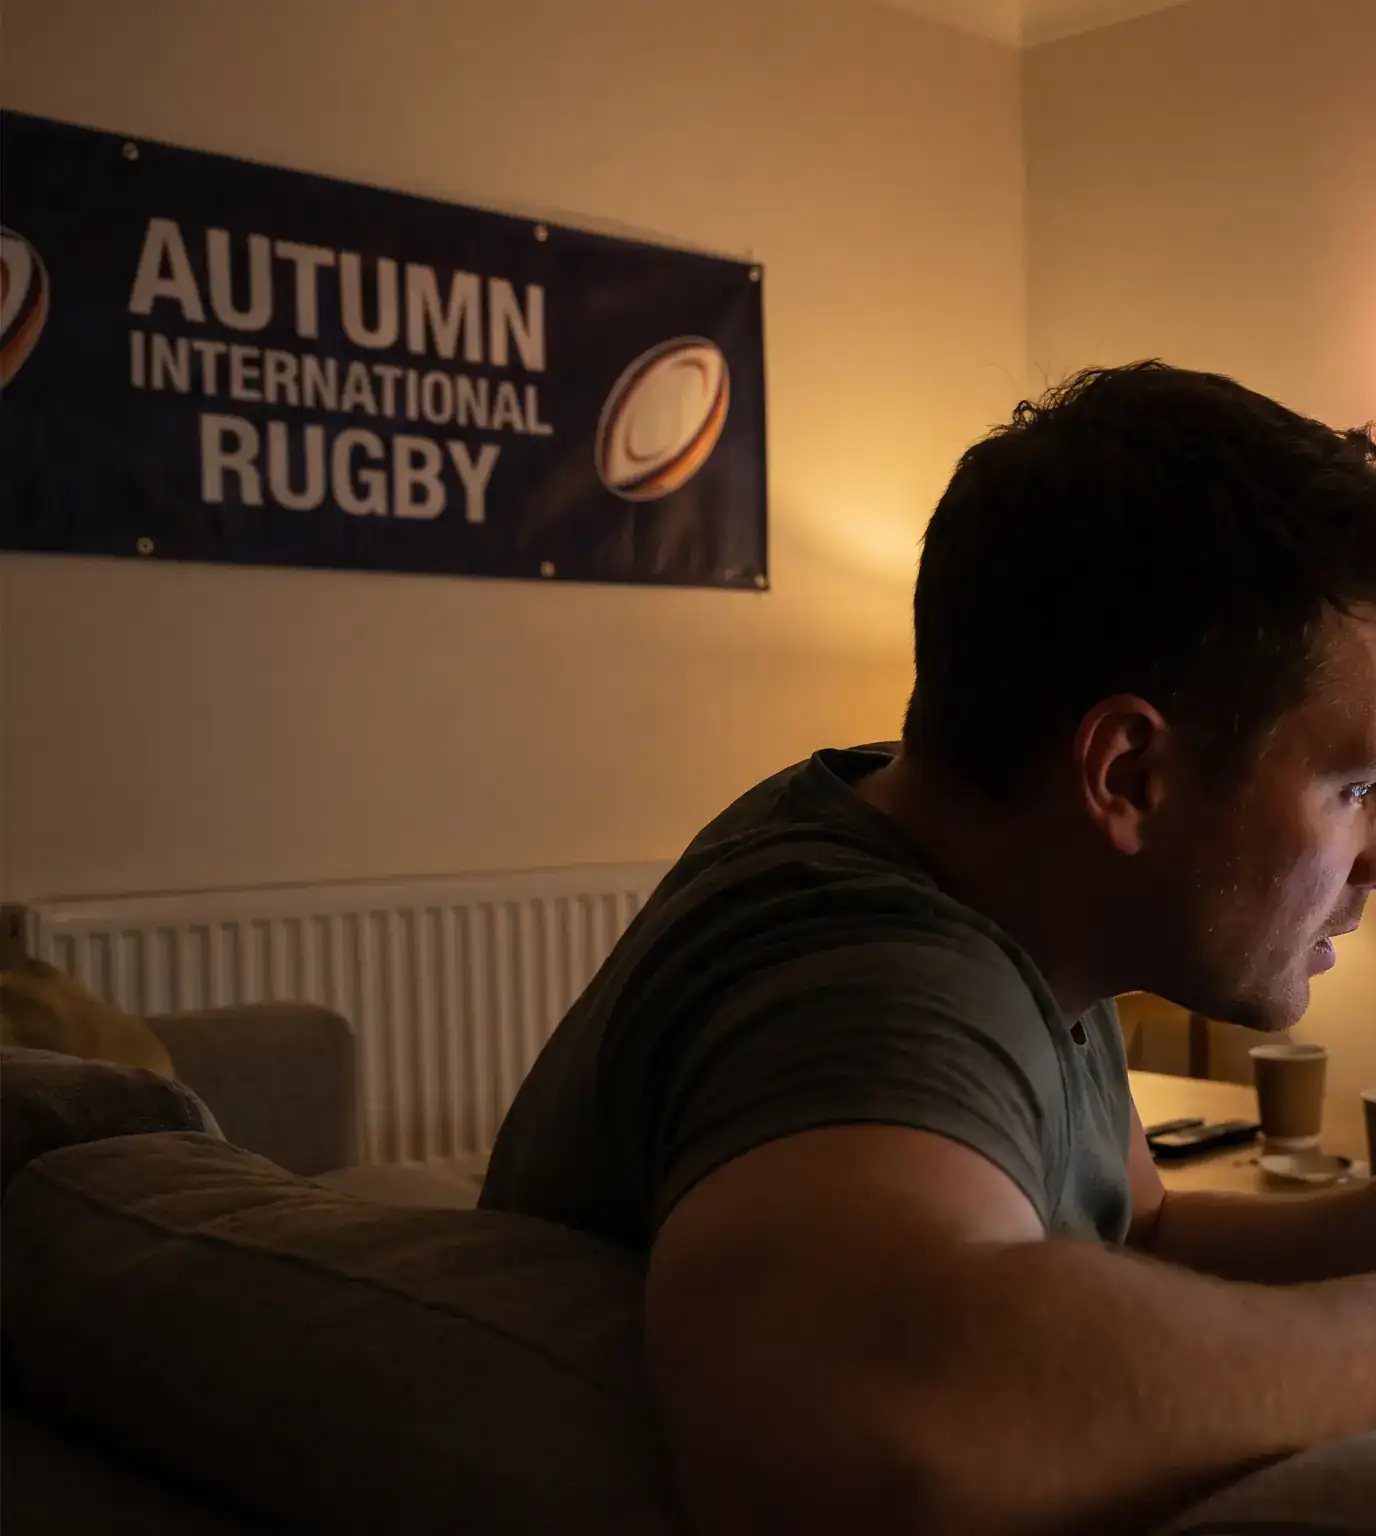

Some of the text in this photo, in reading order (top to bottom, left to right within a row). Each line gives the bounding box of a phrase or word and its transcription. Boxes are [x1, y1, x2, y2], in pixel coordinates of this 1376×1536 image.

[128, 217, 547, 372] AUTUMN
[130, 330, 553, 435] INTERNATIONAL
[200, 413, 500, 523] RUGBY
